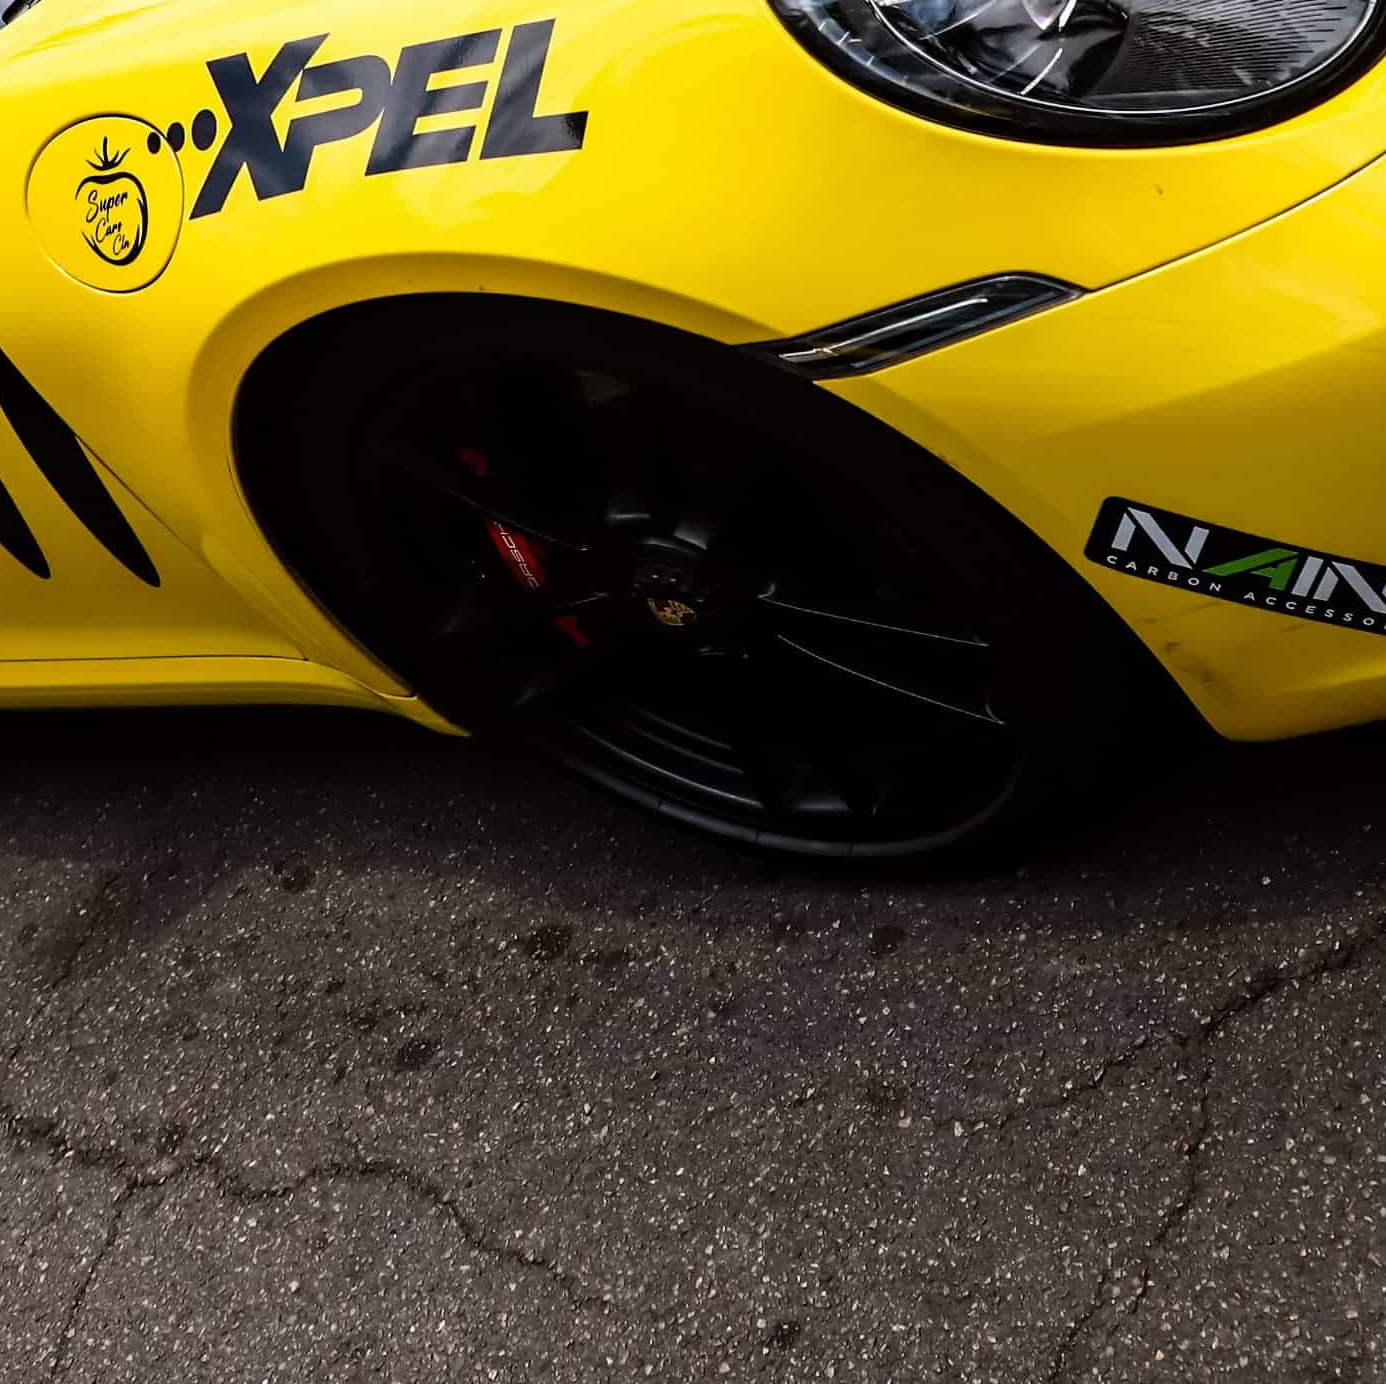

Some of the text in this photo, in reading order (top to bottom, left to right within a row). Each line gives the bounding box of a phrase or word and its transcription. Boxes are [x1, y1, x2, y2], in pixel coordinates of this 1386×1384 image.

[189, 18, 589, 221] XPEL
[85, 189, 129, 223] Super
[1106, 554, 1222, 593] CARBON
